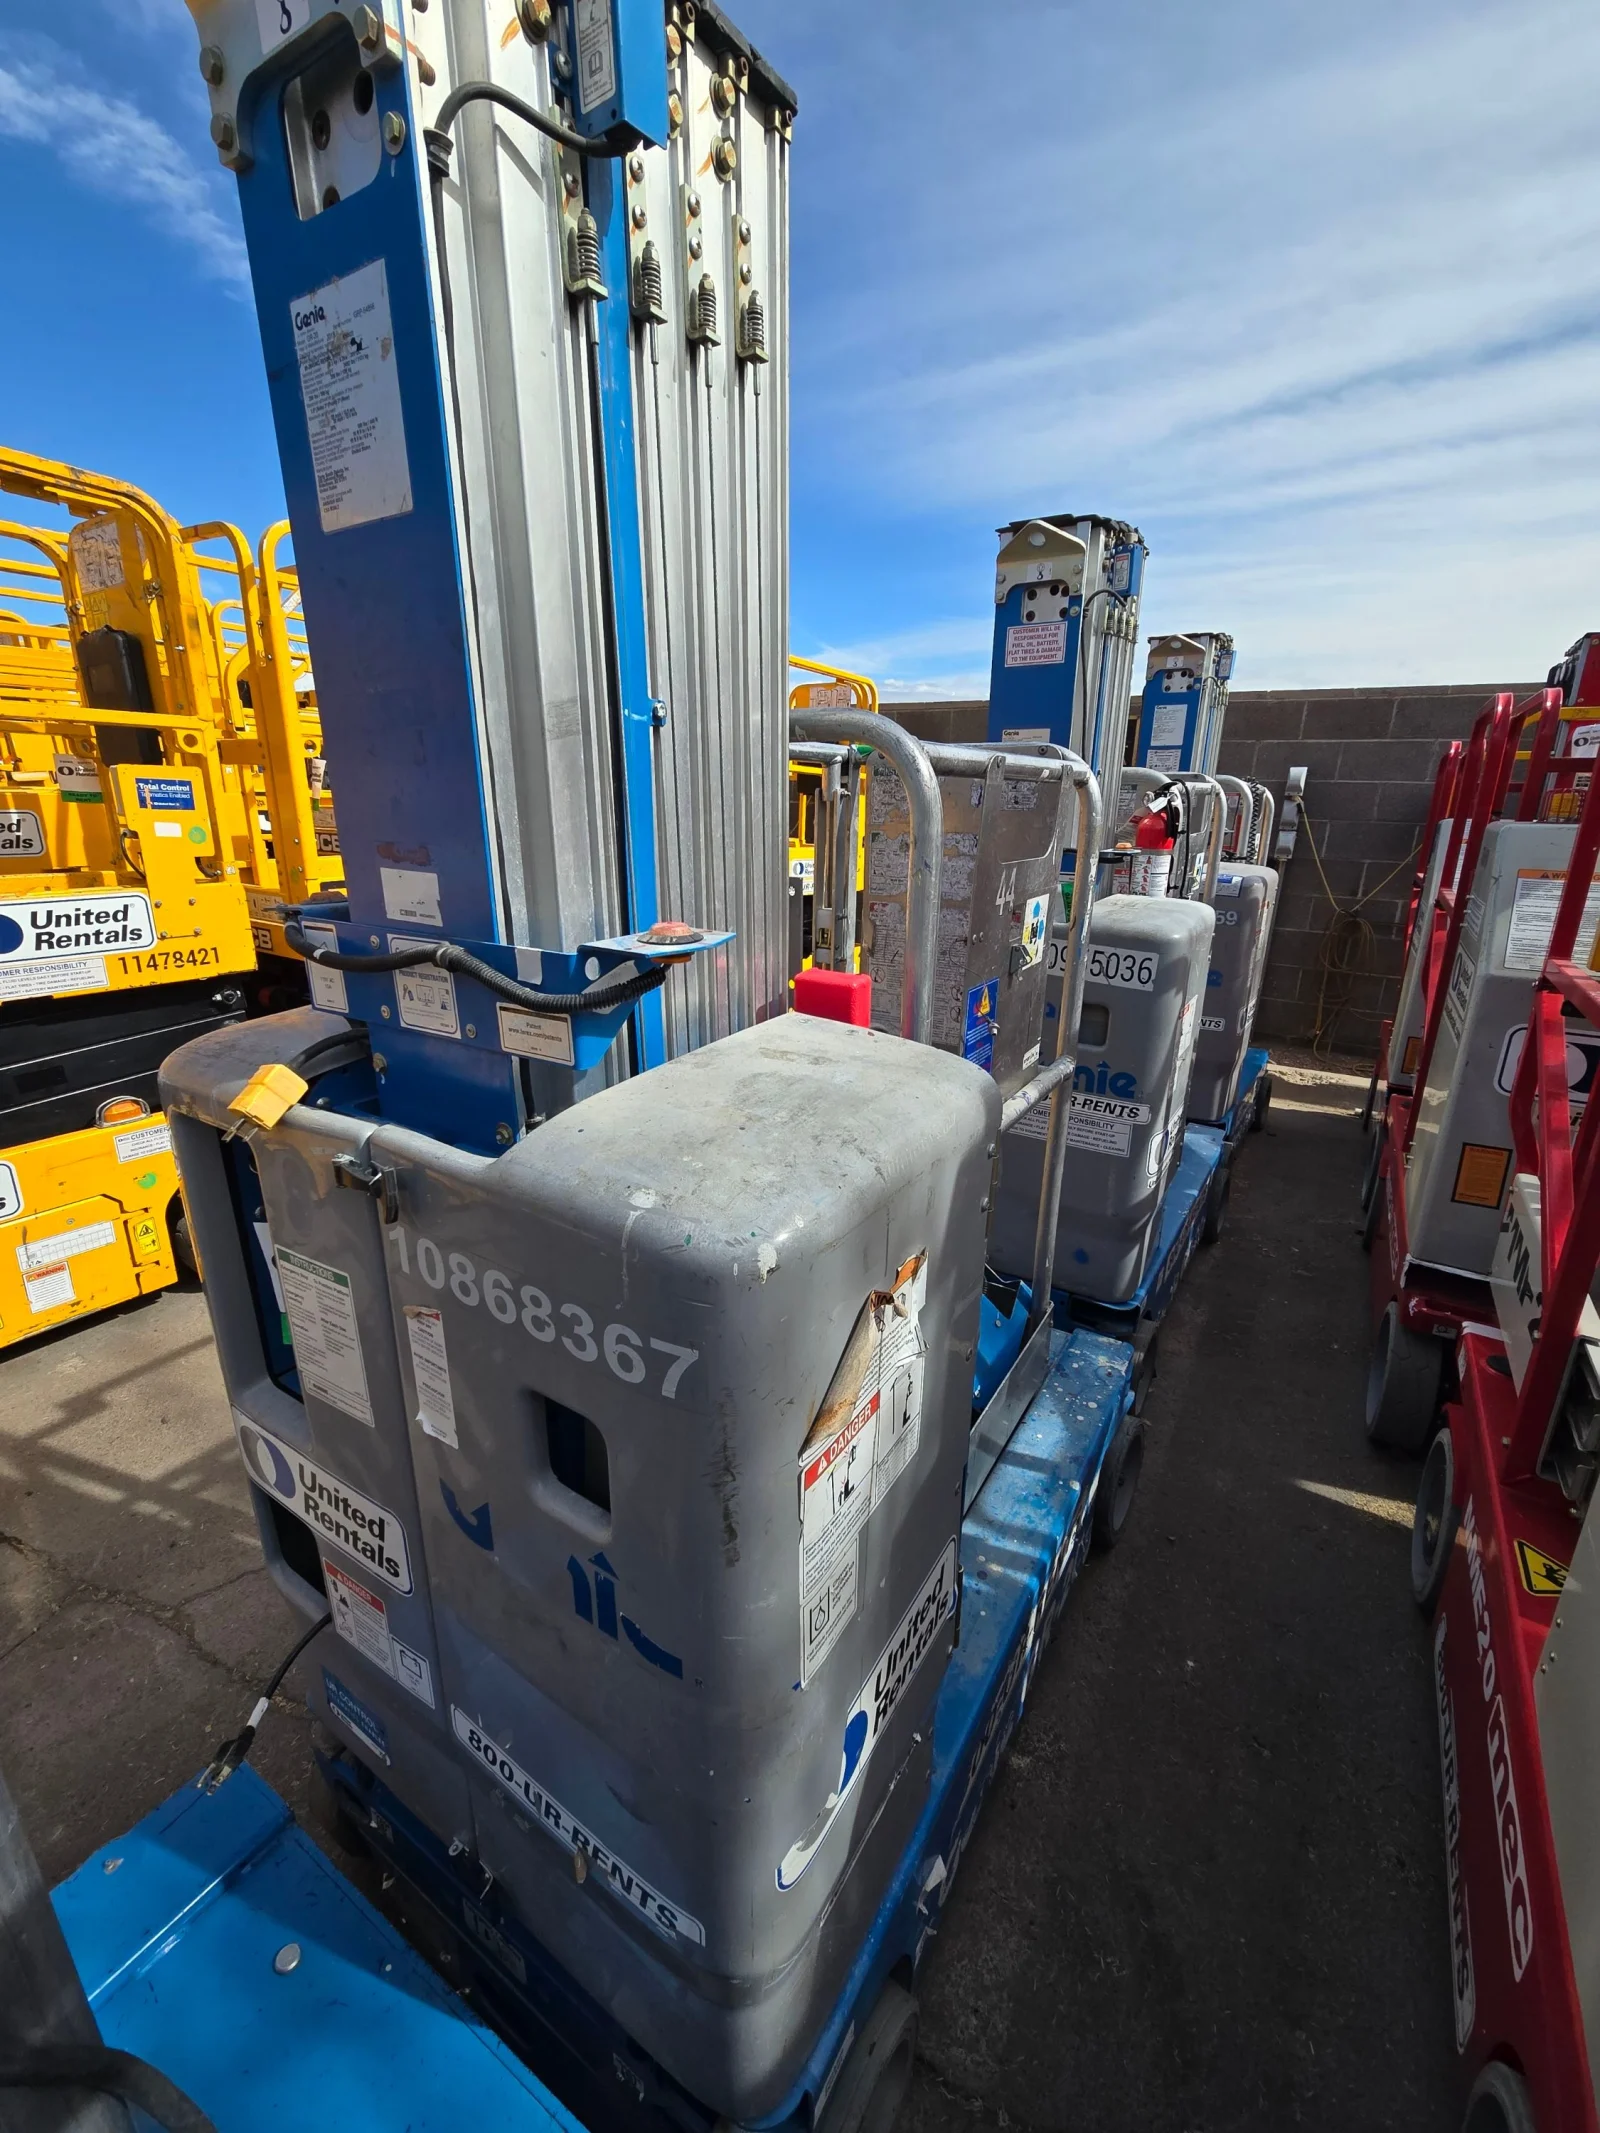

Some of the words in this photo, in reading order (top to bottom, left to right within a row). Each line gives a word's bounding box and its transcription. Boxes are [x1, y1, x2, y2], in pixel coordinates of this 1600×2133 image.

[1014, 634, 1048, 642] RESPONSIBLE
[30, 904, 129, 929] United
[35, 924, 142, 951] Rentals
[22, 961, 88, 974] RESPONSIBILITY
[118, 946, 220, 975] 11478421
[36, 1265, 64, 1278] WARNING
[289, 1254, 334, 1281] INSTRUCTIONS
[388, 1226, 699, 1400] 10868367
[830, 1403, 872, 1459] DANGER
[298, 1462, 386, 1543] United
[304, 1492, 400, 1579] Rentals
[343, 1578, 372, 1604] DANGER
[874, 1563, 946, 1702] United
[872, 1590, 950, 1738] Rentals
[468, 1727, 679, 1932] 800-UR-RENTS
